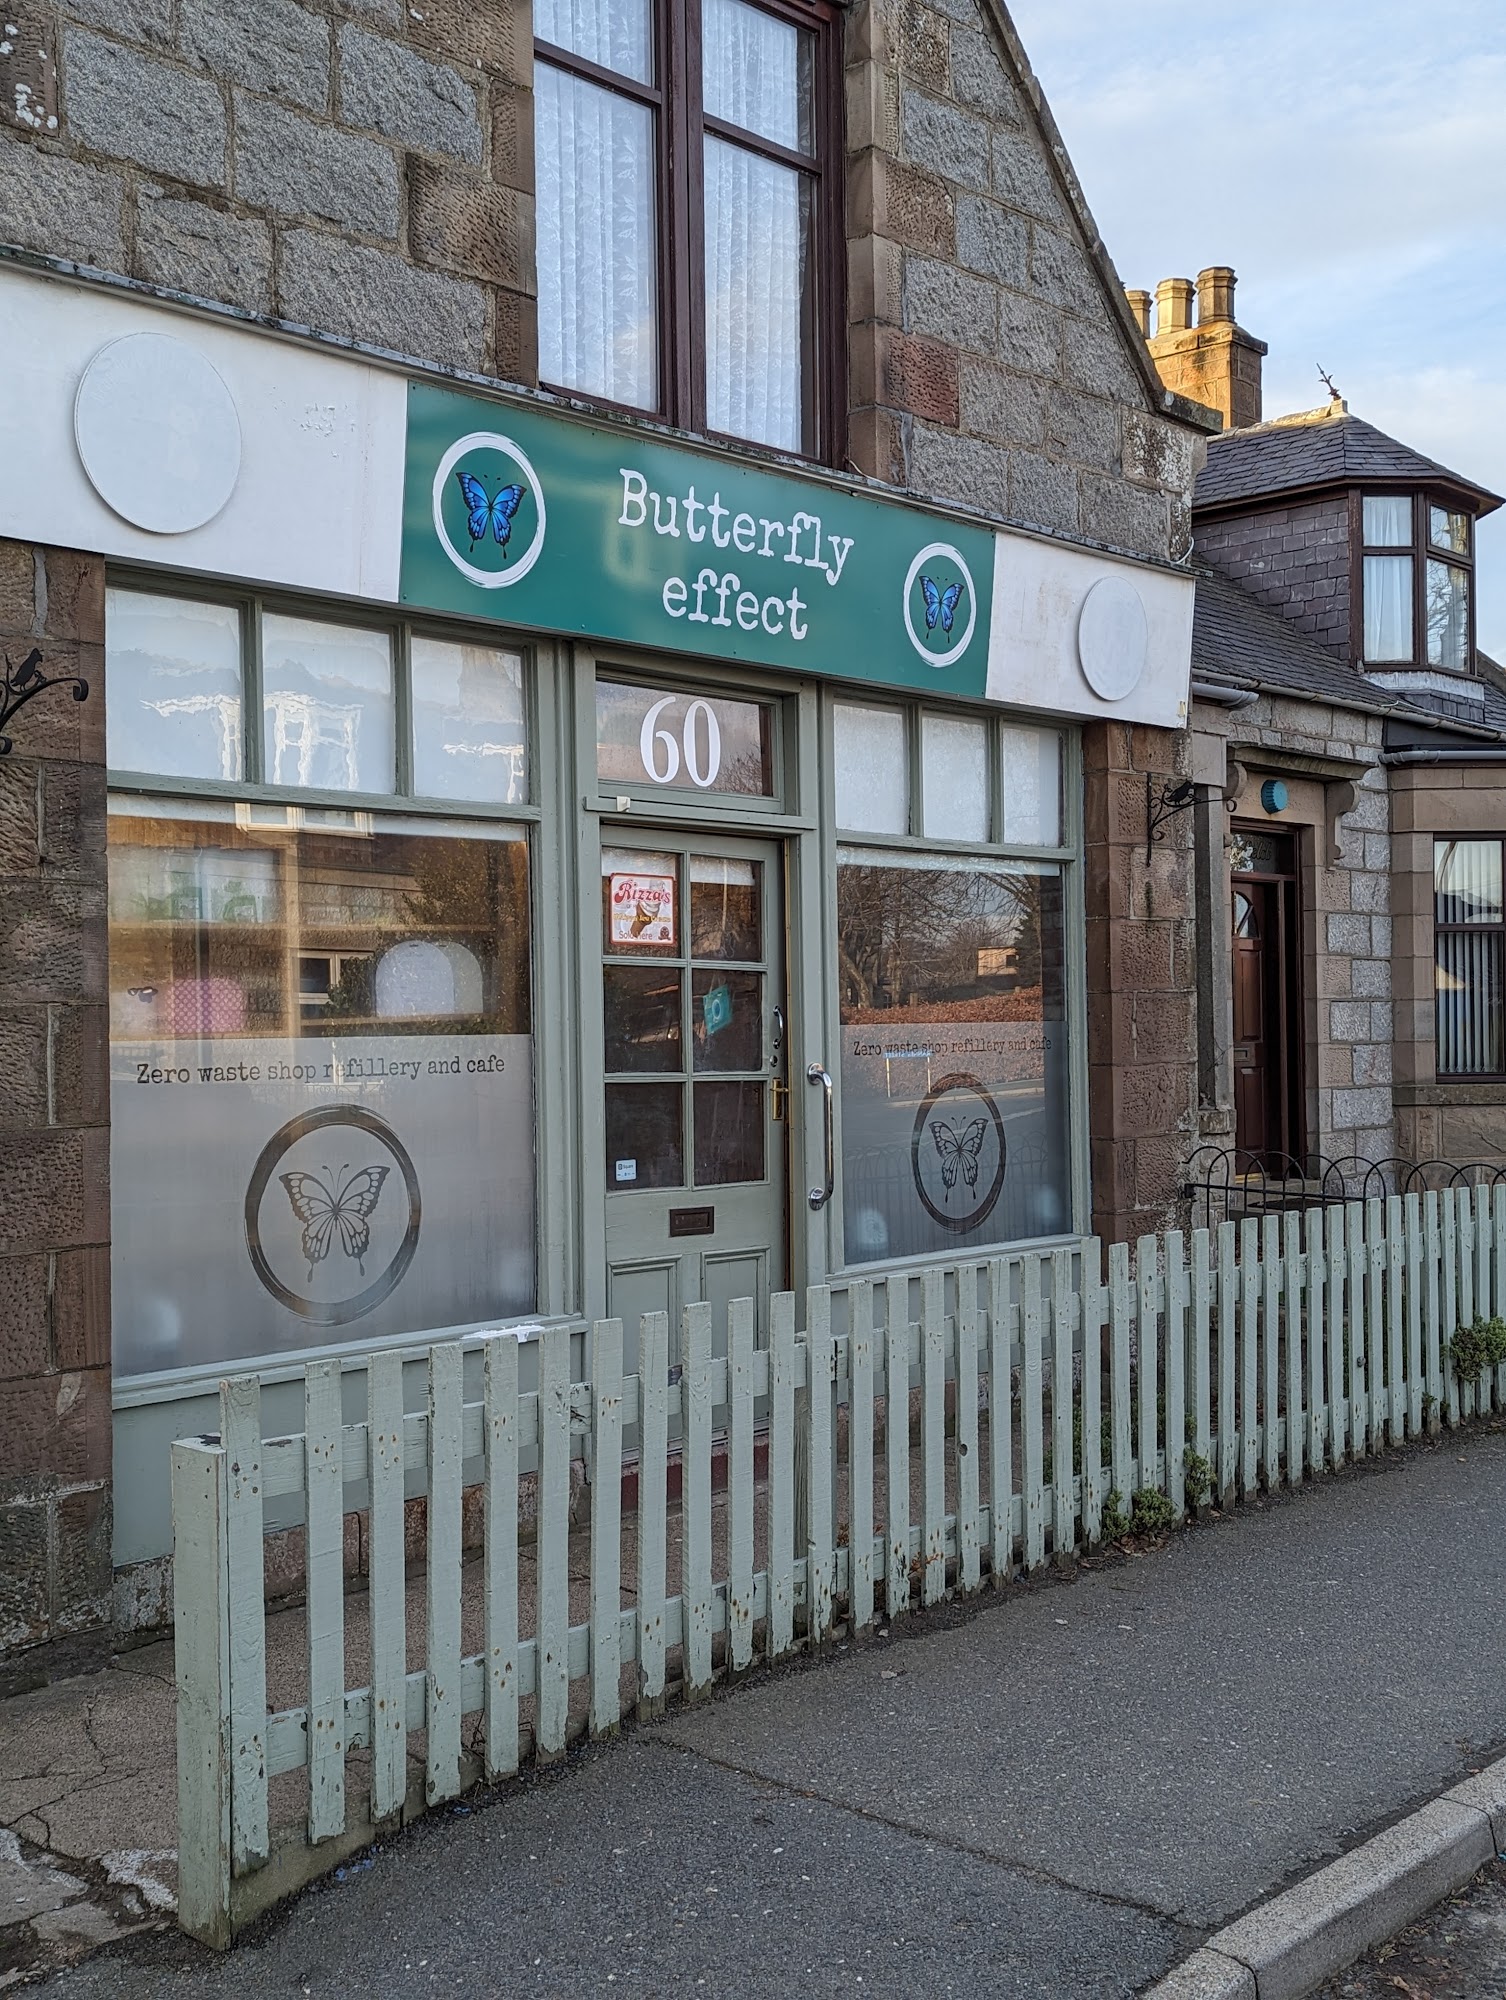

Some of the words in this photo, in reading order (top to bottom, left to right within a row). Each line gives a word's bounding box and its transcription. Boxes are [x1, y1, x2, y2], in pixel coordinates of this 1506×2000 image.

[618, 468, 855, 586] Butterfly
[662, 568, 808, 640] effect
[640, 696, 721, 787] 60
[614, 880, 671, 904] Rizza's
[137, 1063, 190, 1084] Zero
[197, 1062, 260, 1082] waste
[267, 1061, 317, 1084] shop
[323, 1057, 422, 1080] refillery
[427, 1056, 461, 1075] and
[466, 1054, 505, 1073] cafe
[853, 1041, 882, 1056] Zero
[884, 1040, 918, 1053] waste
[921, 1039, 948, 1057] shop
[951, 1038, 1005, 1055] refillery
[1008, 1037, 1028, 1051] and
[1029, 1036, 1053, 1050] cafe
